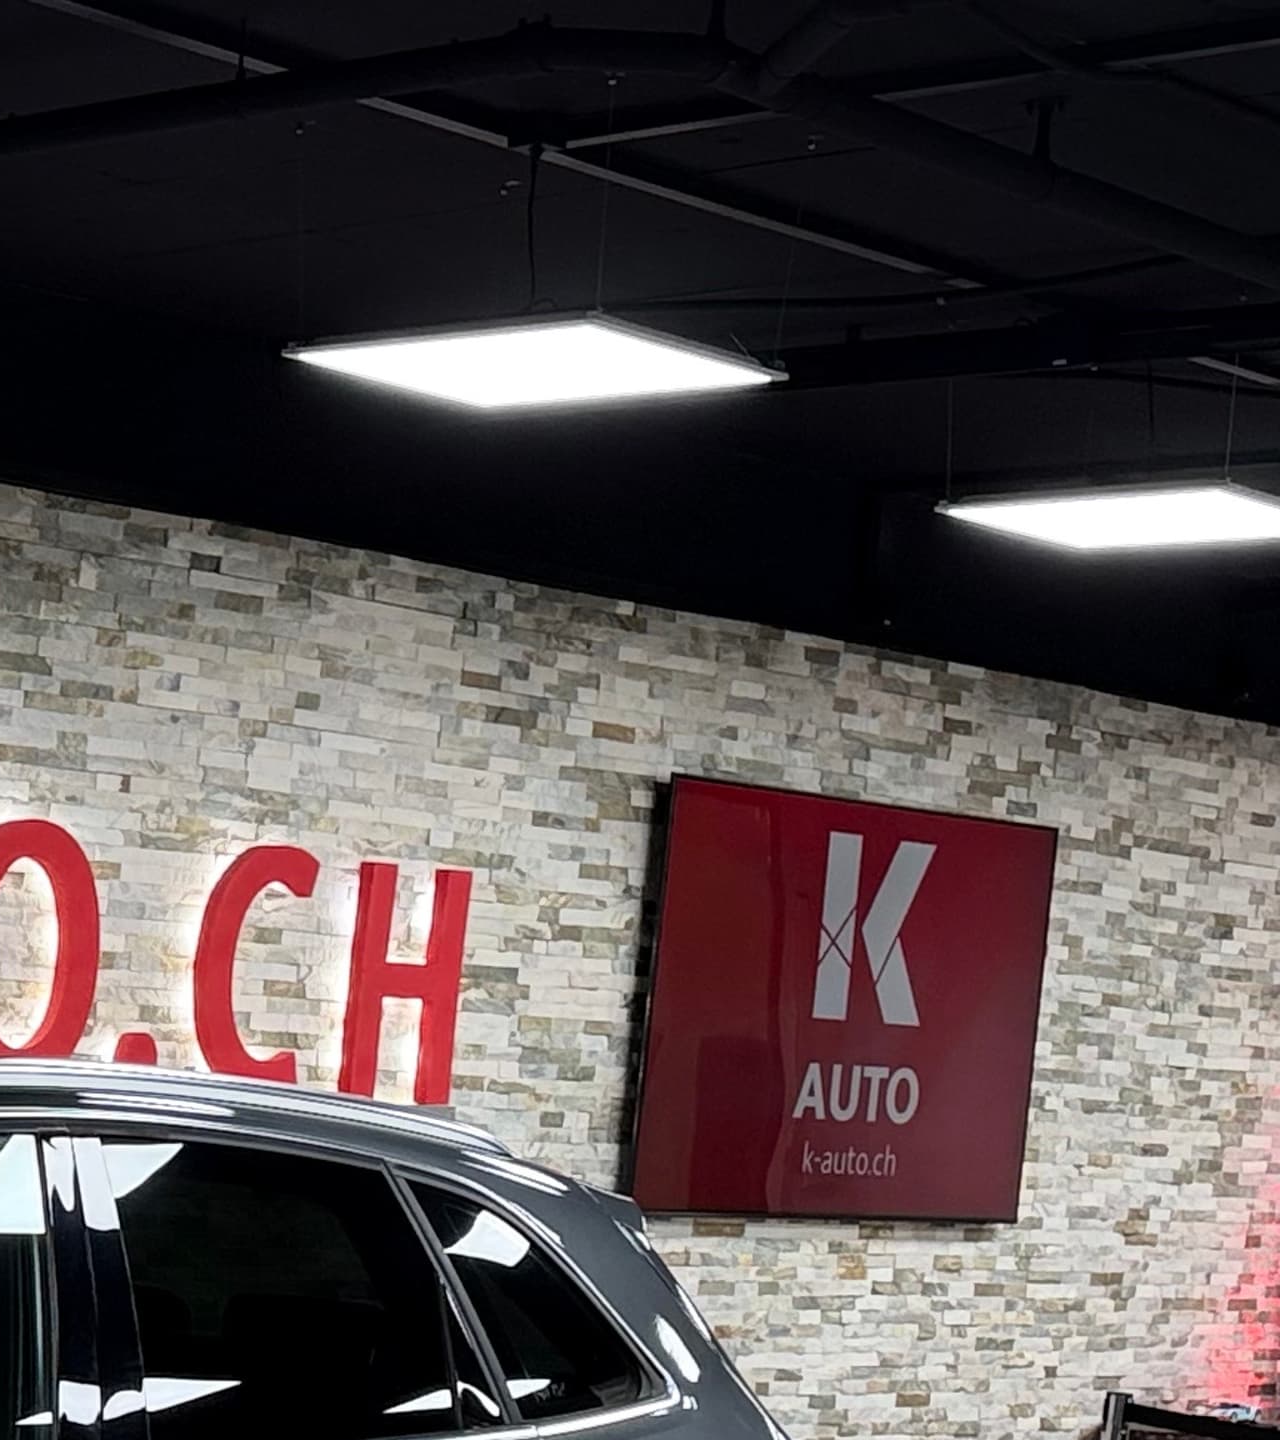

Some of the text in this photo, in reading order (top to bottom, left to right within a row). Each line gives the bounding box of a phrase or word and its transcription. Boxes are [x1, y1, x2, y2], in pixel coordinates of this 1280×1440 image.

[812, 830, 938, 1027] K
[792, 1062, 920, 1124] AUTO
[801, 1142, 896, 1176] k-auto.ch
